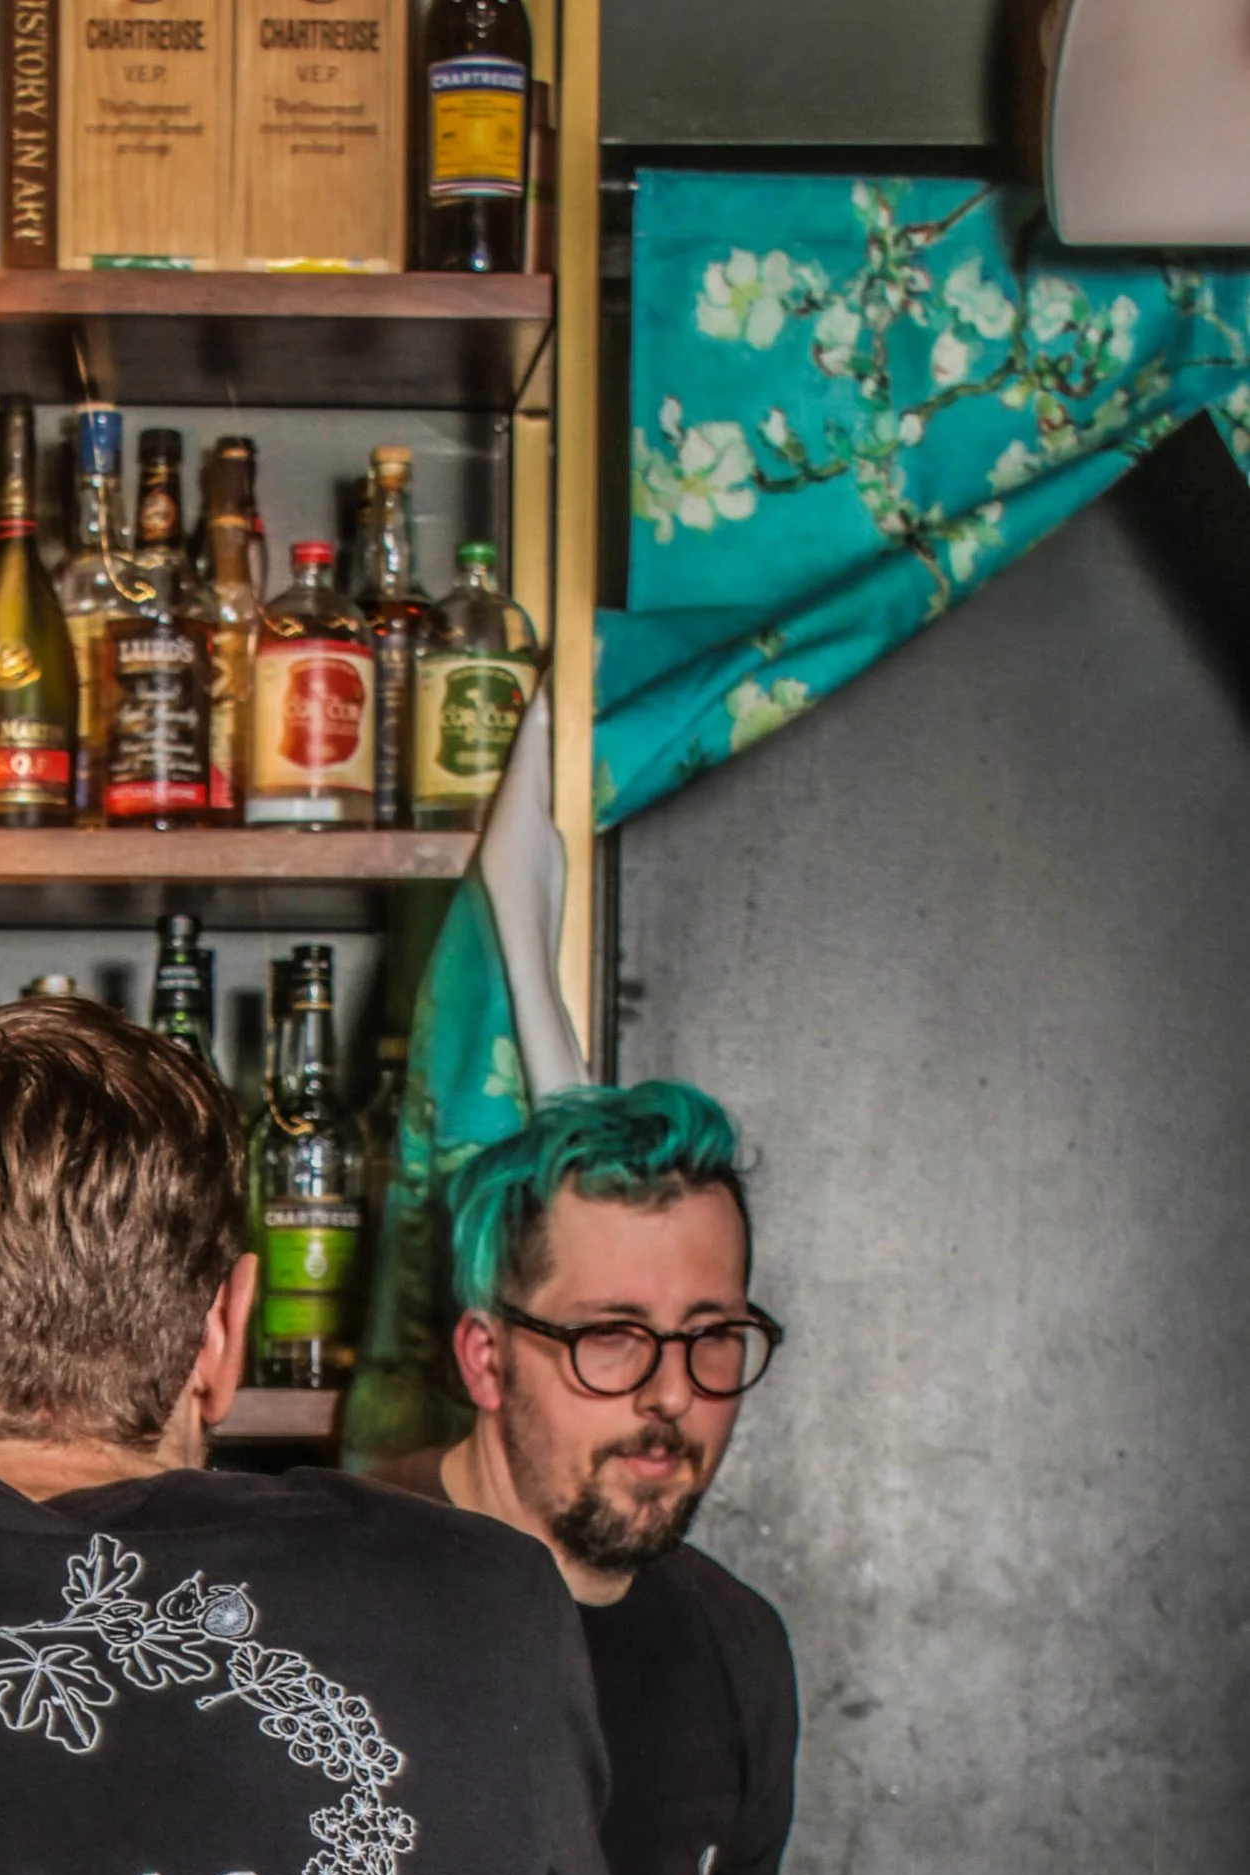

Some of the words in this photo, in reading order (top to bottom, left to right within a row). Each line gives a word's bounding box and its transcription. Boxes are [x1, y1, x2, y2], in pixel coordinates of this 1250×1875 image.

[85, 19, 206, 52] CHARTREUSE
[260, 18, 380, 52] CHARTREUSE
[12, 128, 47, 170] IN
[11, 177, 47, 246] ART
